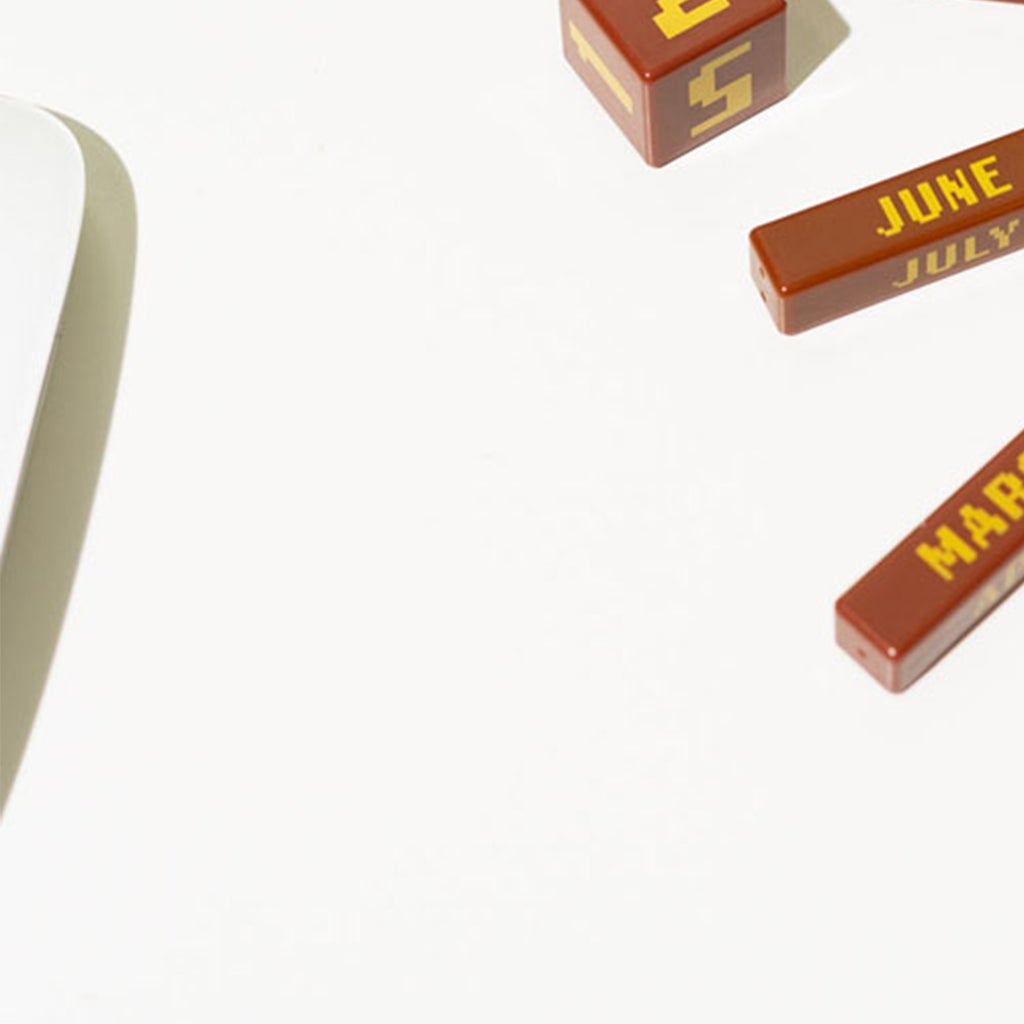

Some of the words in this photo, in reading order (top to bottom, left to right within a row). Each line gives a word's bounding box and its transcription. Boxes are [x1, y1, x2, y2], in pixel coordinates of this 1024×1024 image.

[687, 40, 752, 138] 5
[876, 154, 1014, 238] JUNE
[891, 218, 1021, 289] JULY
